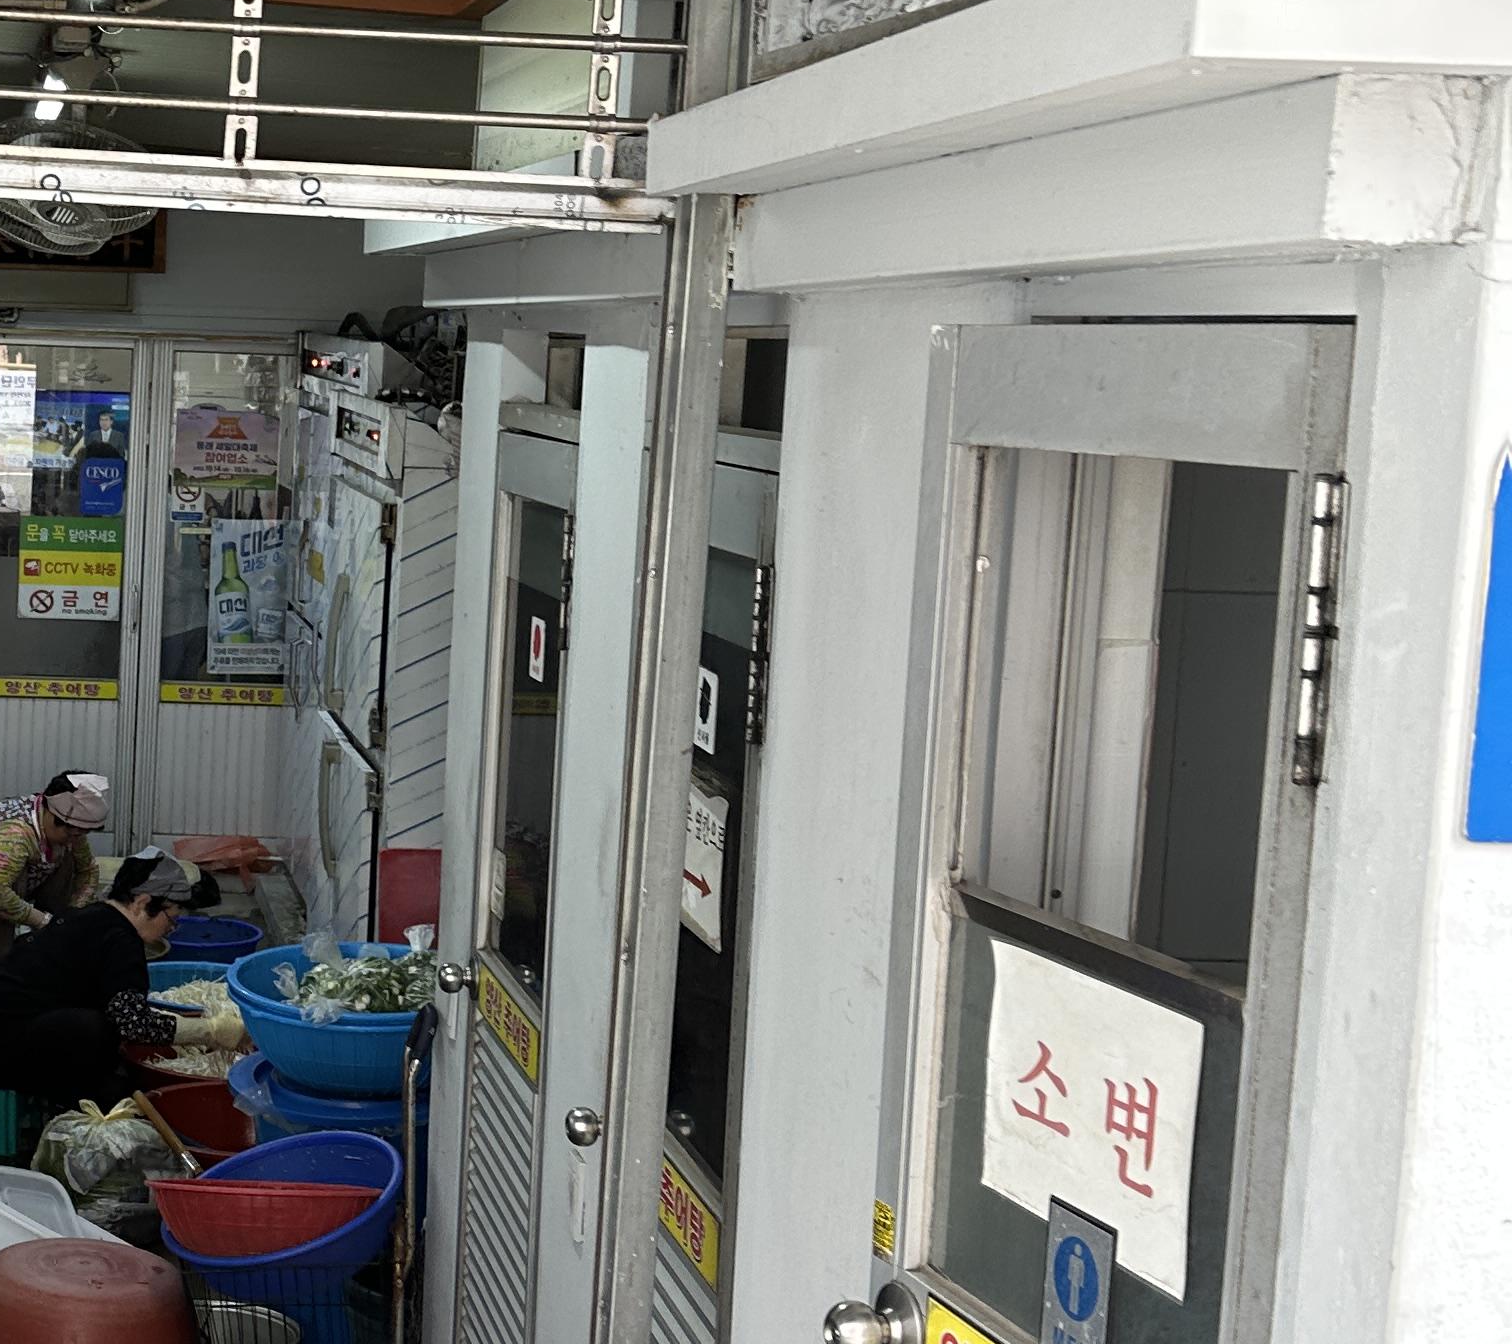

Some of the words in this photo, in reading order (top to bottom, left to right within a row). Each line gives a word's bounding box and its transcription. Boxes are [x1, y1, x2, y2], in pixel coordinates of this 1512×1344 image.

[85, 466, 120, 479] CESCO
[26, 523, 49, 543] 문을
[52, 524, 66, 544] 꼭
[69, 529, 117, 544] 닫아주세요
[44, 561, 80, 575] CCTV
[83, 561, 117, 577] 녹화중
[5, 680, 40, 694] 양산
[47, 682, 101, 697] 추어탕
[177, 686, 214, 701] 양산
[220, 687, 275, 703] 추어탕
[1012, 1040, 1159, 1198] 소변
